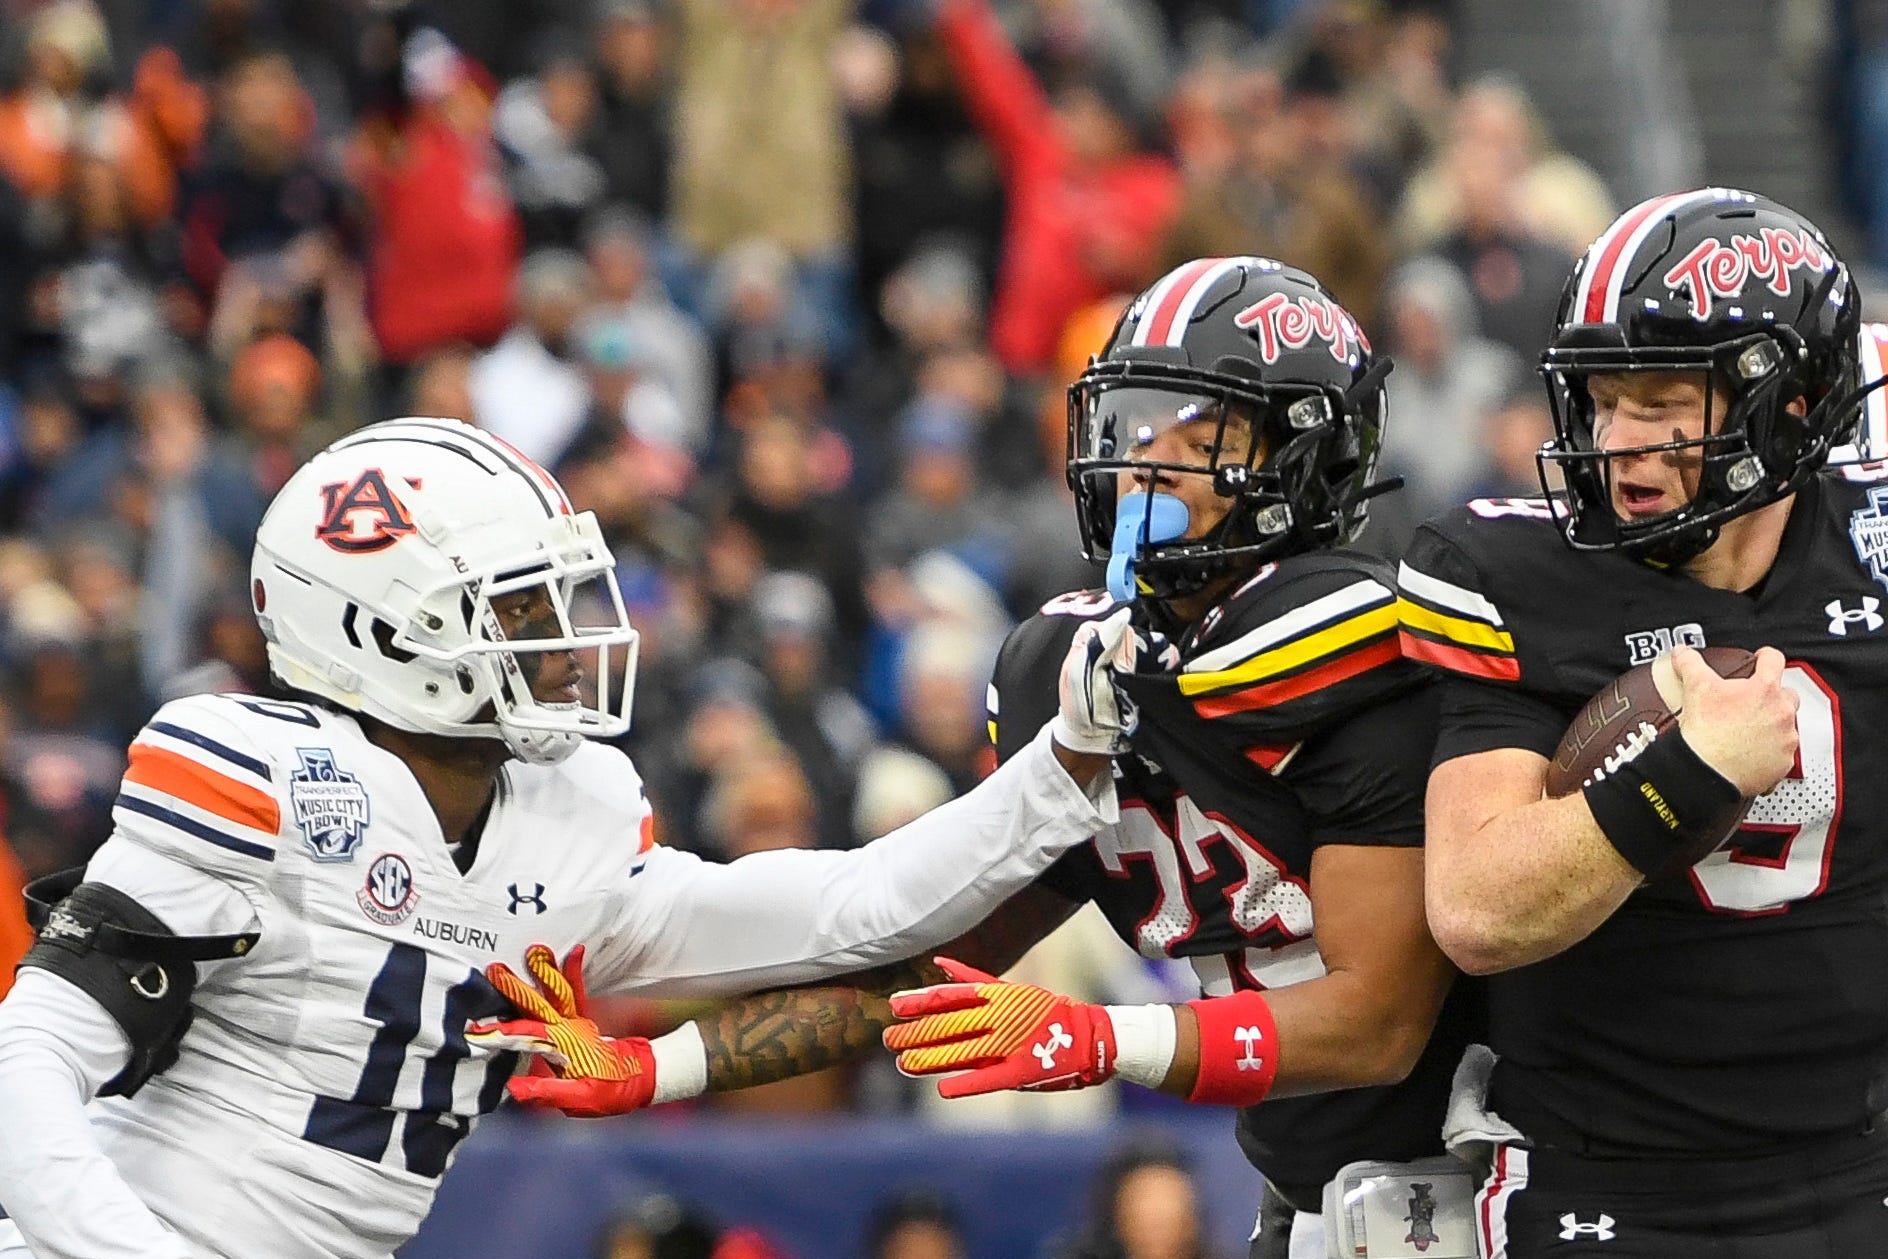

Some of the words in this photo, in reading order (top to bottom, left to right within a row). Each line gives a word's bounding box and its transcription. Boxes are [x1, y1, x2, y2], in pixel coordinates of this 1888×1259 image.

[296, 798, 334, 819] MUSIC
[335, 798, 364, 818] CITY
[1640, 782, 1680, 830] MARYLAND
[314, 814, 352, 831] BOWL
[413, 917, 499, 952] AUBURN
